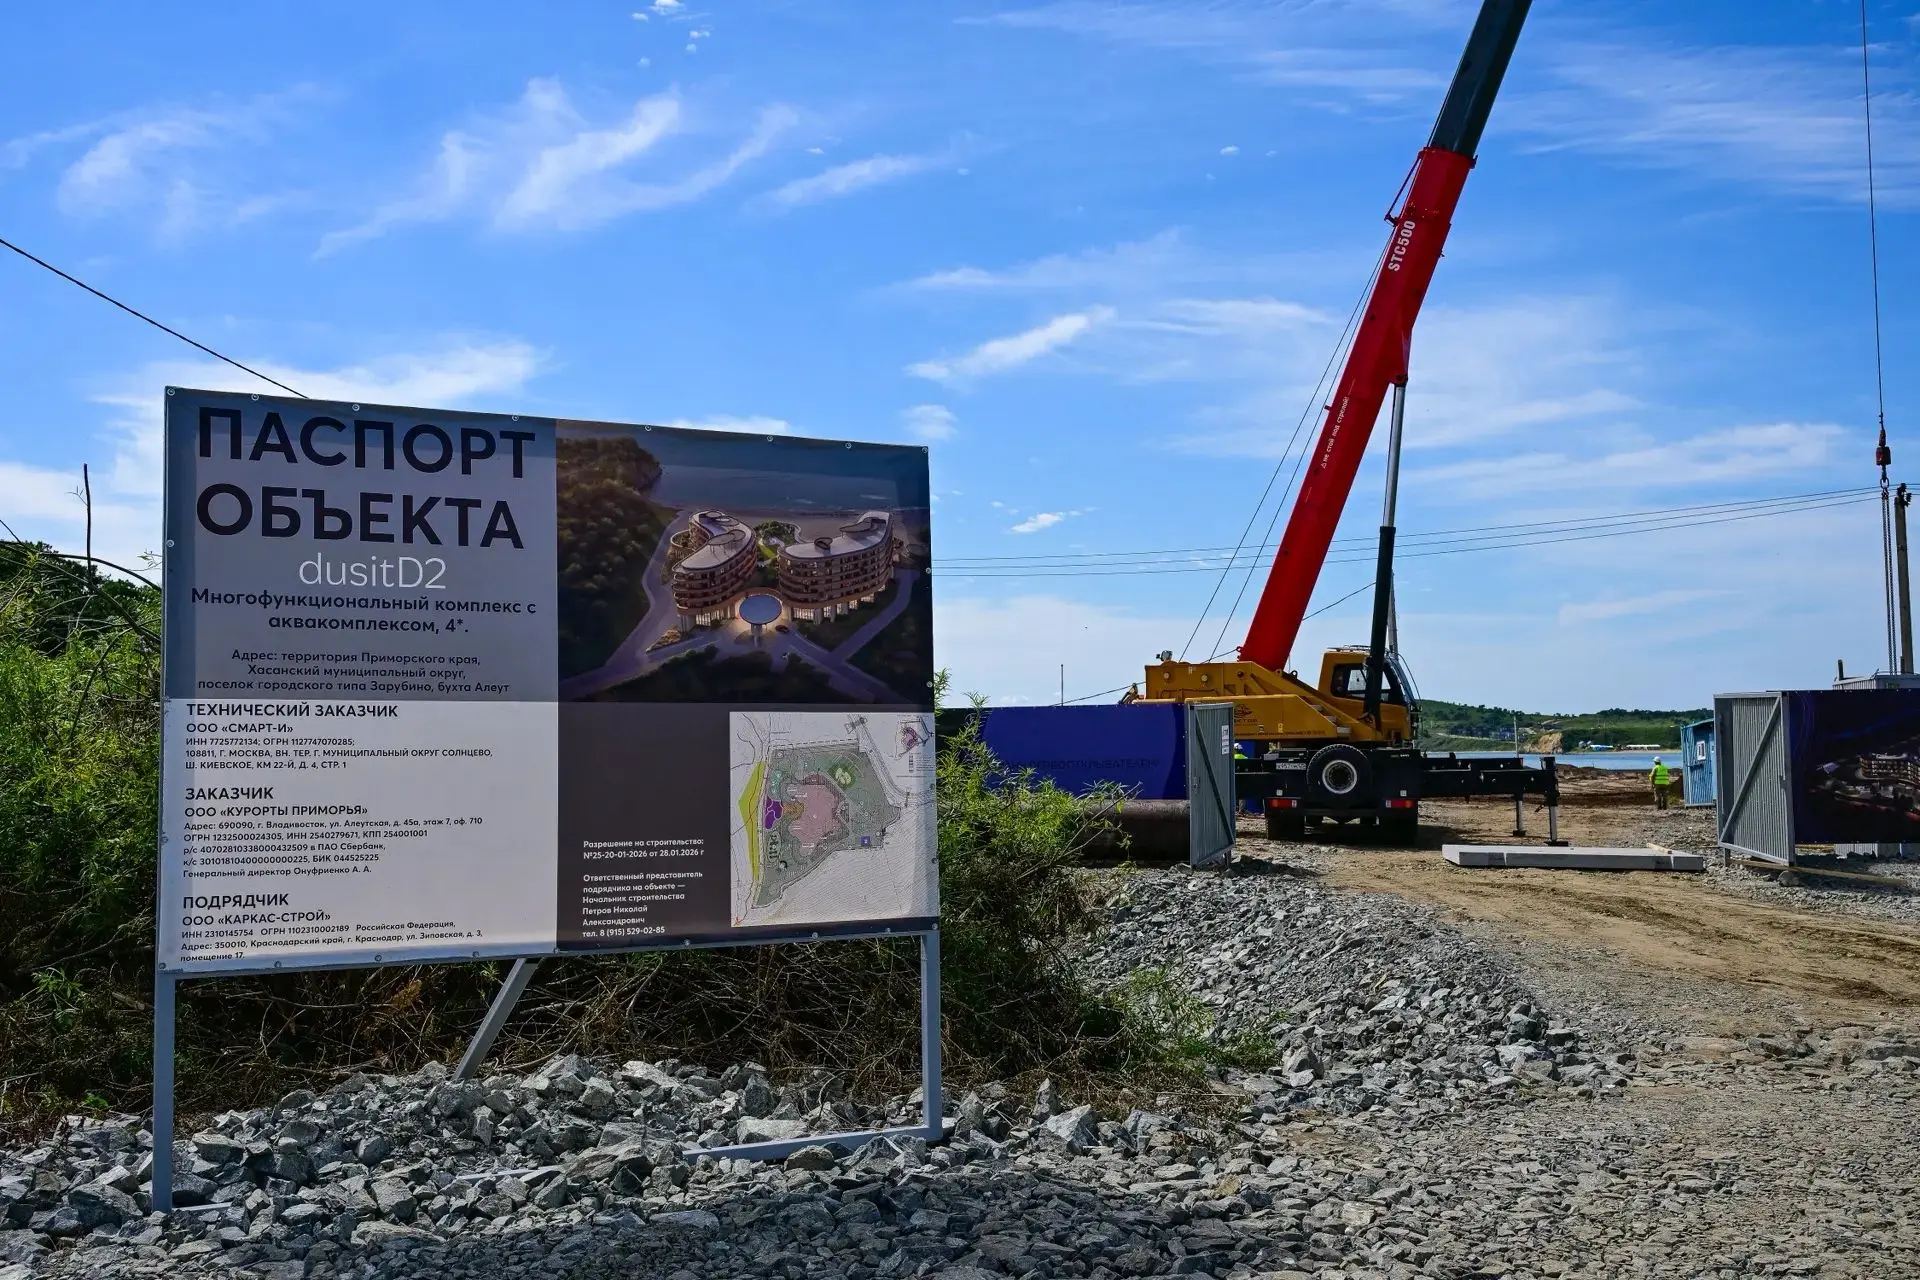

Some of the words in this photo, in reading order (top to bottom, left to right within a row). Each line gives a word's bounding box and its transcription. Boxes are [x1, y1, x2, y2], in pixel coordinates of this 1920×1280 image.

[1388, 220, 1416, 272] STC500
[199, 407, 536, 479] ПАСПОРТ
[197, 483, 525, 550] ОБЪЕКТА
[300, 552, 447, 590] dusitD2
[192, 588, 429, 610] Многофункциональный
[435, 600, 522, 613] комплекс
[527, 603, 537, 614] с
[269, 616, 439, 635] аквакомплексом,
[232, 650, 277, 662] Адрес:
[282, 653, 357, 663] территория
[362, 653, 445, 664] Приморского
[450, 656, 481, 666] края,
[248, 664, 320, 676] Хасанский
[324, 668, 426, 679] муниципальный
[430, 670, 466, 680] округ,
[199, 681, 254, 689] поселок
[258, 682, 333, 691] городского
[337, 683, 367, 691] типа
[371, 681, 434, 693] Зарубино,
[438, 682, 471, 694] бухта
[475, 683, 509, 694] Алеут
[187, 702, 310, 717] ТЕХНИЧЕСКИЙ
[315, 705, 398, 717] ЗАКАЗЧИК
[187, 723, 218, 733] ООО
[222, 723, 294, 733] «СМАРТ-И»
[186, 738, 207, 746] ИНН
[210, 738, 261, 747] 7725772134;
[263, 738, 289, 746] ОГРН
[292, 738, 355, 747] 1127747070285;
[186, 750, 217, 759] 108811,
[220, 750, 227, 758] Г.
[229, 750, 273, 759] МОСКВА,
[276, 750, 291, 758] ВН.
[294, 750, 312, 758] ТЕР.
[314, 750, 321, 758] Г.
[323, 748, 409, 758] МУНИЦИПАЛЬНЫЙ
[442, 750, 493, 758] СОЛНЦЕВО,
[186, 761, 198, 769] Ш.
[201, 762, 255, 770] КИЕВСКОЕ,
[274, 760, 297, 770] 22-Й,
[299, 762, 309, 771] Д.
[311, 762, 319, 770] 4,
[321, 761, 340, 769] СТР.
[342, 761, 347, 769] 1
[185, 787, 274, 801] ЗАКАЗЧИК
[185, 807, 217, 817] ООО
[221, 806, 288, 817] «КУРОРТЫ
[292, 805, 368, 816] ПРИМОРЬЯ»
[184, 823, 216, 831] Адрес:
[219, 822, 255, 831] 690090,
[267, 821, 327, 830] Владивосток,
[344, 820, 391, 829] Алеутская,
[393, 820, 401, 828] д.
[446, 818, 452, 827] 7,
[454, 818, 468, 826] оф.
[184, 834, 211, 842] ОГРН
[213, 833, 284, 842] 1232500024305,
[310, 831, 361, 840] 2540279671,
[363, 831, 382, 839] КПП
[384, 830, 428, 838] 254001001
[184, 847, 198, 856] р/с
[340, 843, 386, 852] Сбербанк,
[583, 841, 633, 849] Разрешение
[646, 839, 704, 847] строительство:
[184, 858, 198, 867] к/с
[313, 855, 332, 863] БИК
[334, 854, 379, 862] 044525225
[583, 850, 648, 859] №25-20-01-2026
[660, 849, 699, 857] 28.01.2026
[183, 868, 246, 879] Генеральный
[248, 869, 292, 877] директор
[294, 866, 350, 876] Онуфриенко
[583, 873, 644, 882] Ответственный
[646, 872, 703, 880] представитель
[583, 885, 631, 894] подрядчика
[645, 883, 676, 891] объекте
[183, 893, 289, 910] ПОДРЯДЧИК
[583, 896, 627, 904] Начальник
[629, 894, 685, 902] строительства
[583, 907, 612, 915] Петров
[614, 905, 648, 913] Николай
[183, 915, 214, 926] ООО
[218, 909, 331, 925] «КАРКАС-СТРОЙ»
[583, 918, 645, 927] Александрович
[182, 931, 203, 939] ИНН
[205, 929, 254, 938] 2310145754
[261, 928, 286, 936] ОГРН
[288, 925, 350, 934] 1102310002189
[356, 922, 405, 932] Российская
[407, 921, 456, 930] Федерация,
[607, 928, 625, 937] (915)
[627, 926, 666, 935] 529-02-85
[181, 943, 212, 951] Адрес:
[215, 941, 248, 950] 350010,
[251, 937, 320, 948] Краснодарский
[322, 937, 345, 945] край,
[356, 934, 404, 943] Краснодар,
[420, 932, 465, 940] Зиповская,
[477, 930, 483, 938] 3,
[181, 954, 233, 962] помещение
